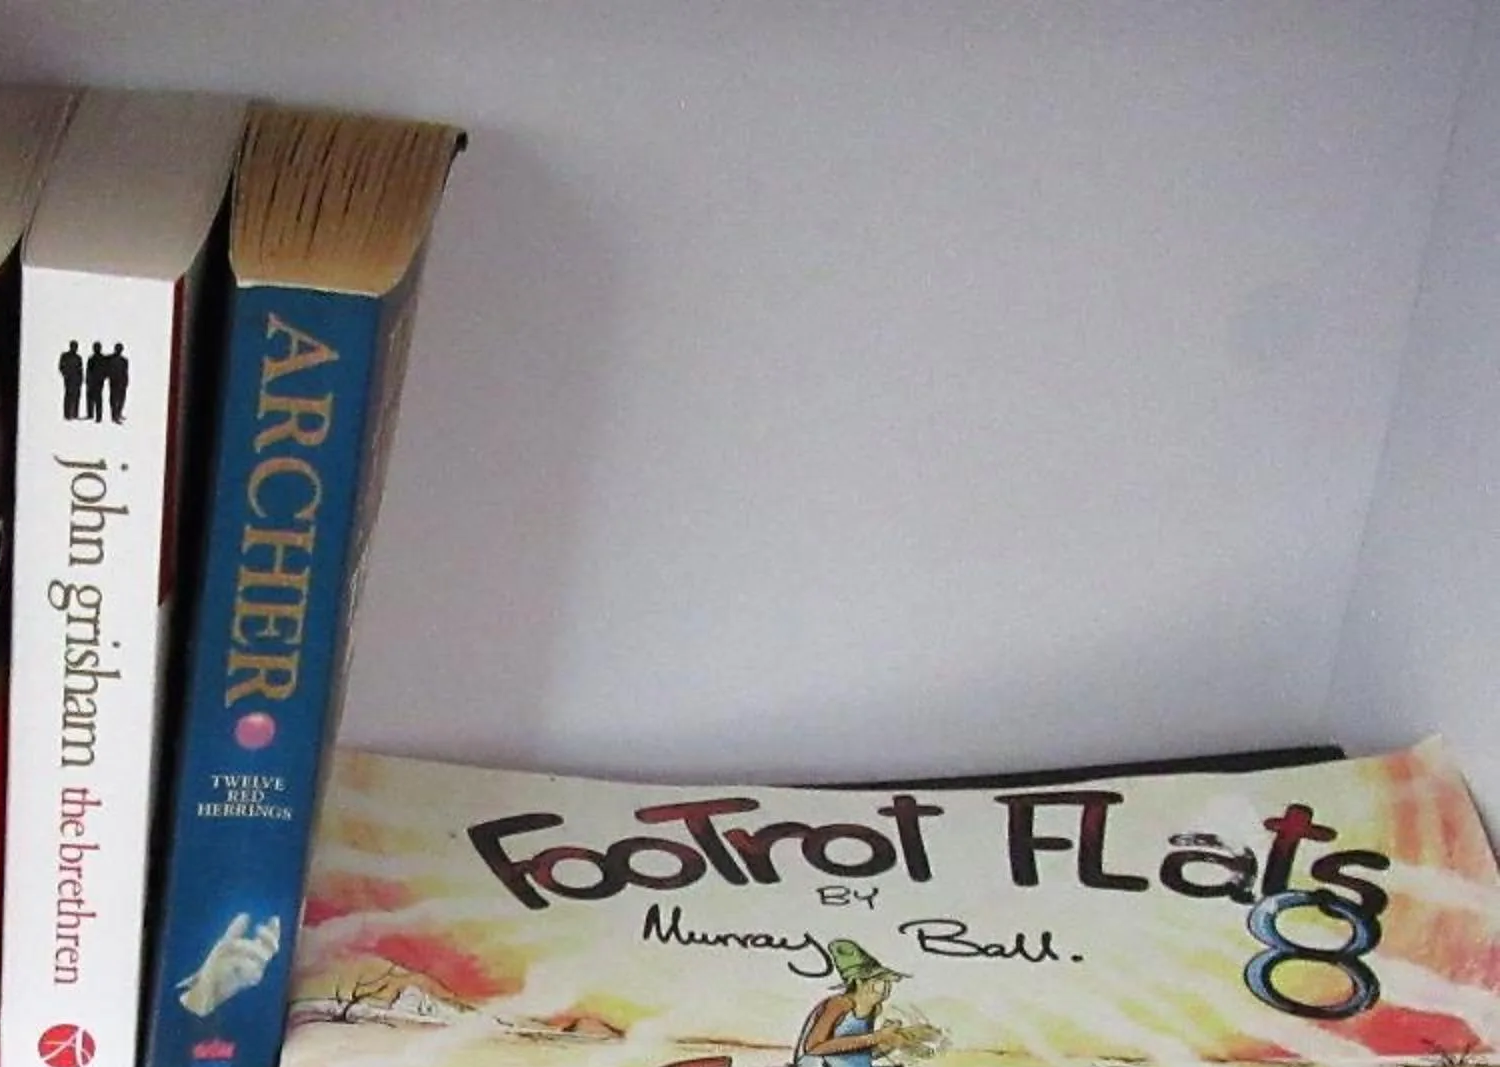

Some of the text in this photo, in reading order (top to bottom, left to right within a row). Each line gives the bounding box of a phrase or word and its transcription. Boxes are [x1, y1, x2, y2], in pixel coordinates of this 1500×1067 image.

[226, 312, 339, 708] ARCHER
[48, 454, 130, 769] john grisham
[197, 802, 293, 820] HERRINGS
[211, 775, 285, 791] TWELVE
[226, 789, 265, 802] RED
[642, 903, 835, 978] Murray
[1244, 888, 1381, 1020] 8
